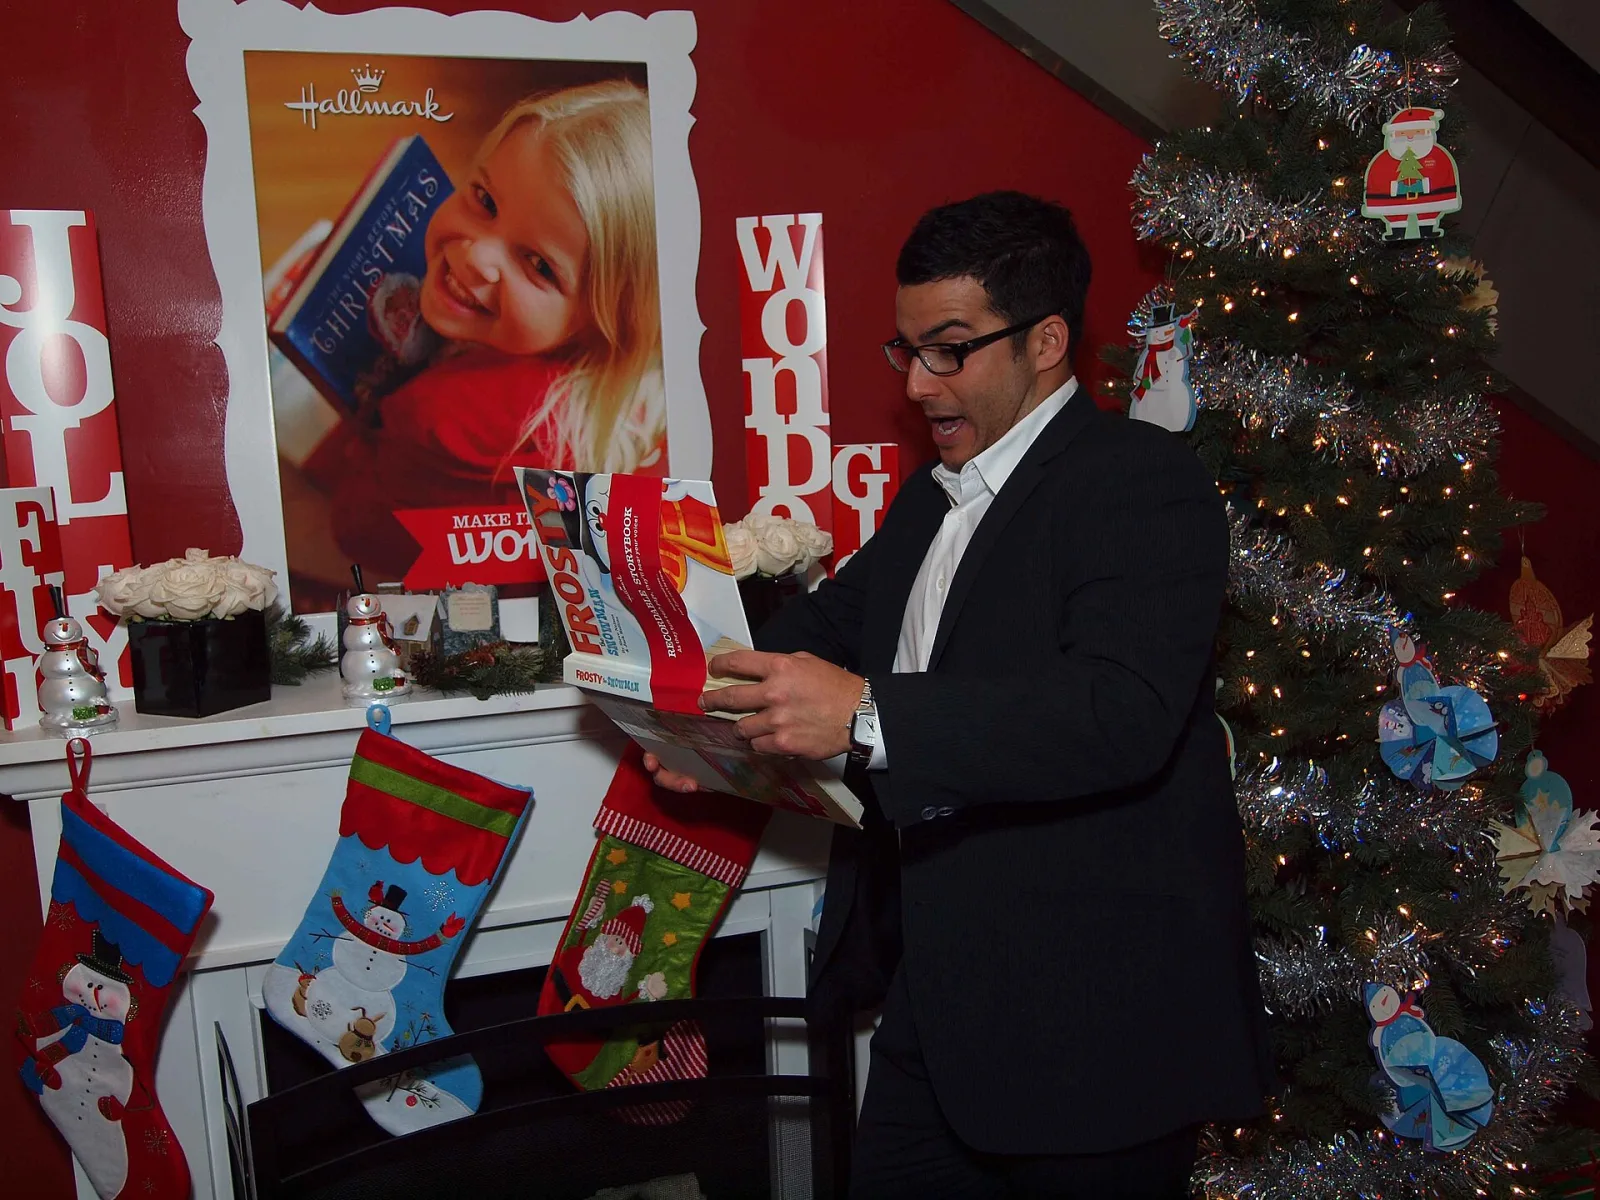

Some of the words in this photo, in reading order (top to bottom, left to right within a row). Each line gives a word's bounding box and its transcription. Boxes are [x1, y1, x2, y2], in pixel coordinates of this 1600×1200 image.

[284, 82, 454, 130] Hallmark
[309, 168, 439, 355] CHRISTMAS
[452, 513, 512, 529] MAKE
[623, 506, 642, 586] STORYBOOK
[526, 484, 603, 656] FROSTY
[588, 587, 619, 657] SNOWMAN
[638, 589, 677, 658] RECORDABLE
[576, 669, 603, 685] FROSTY
